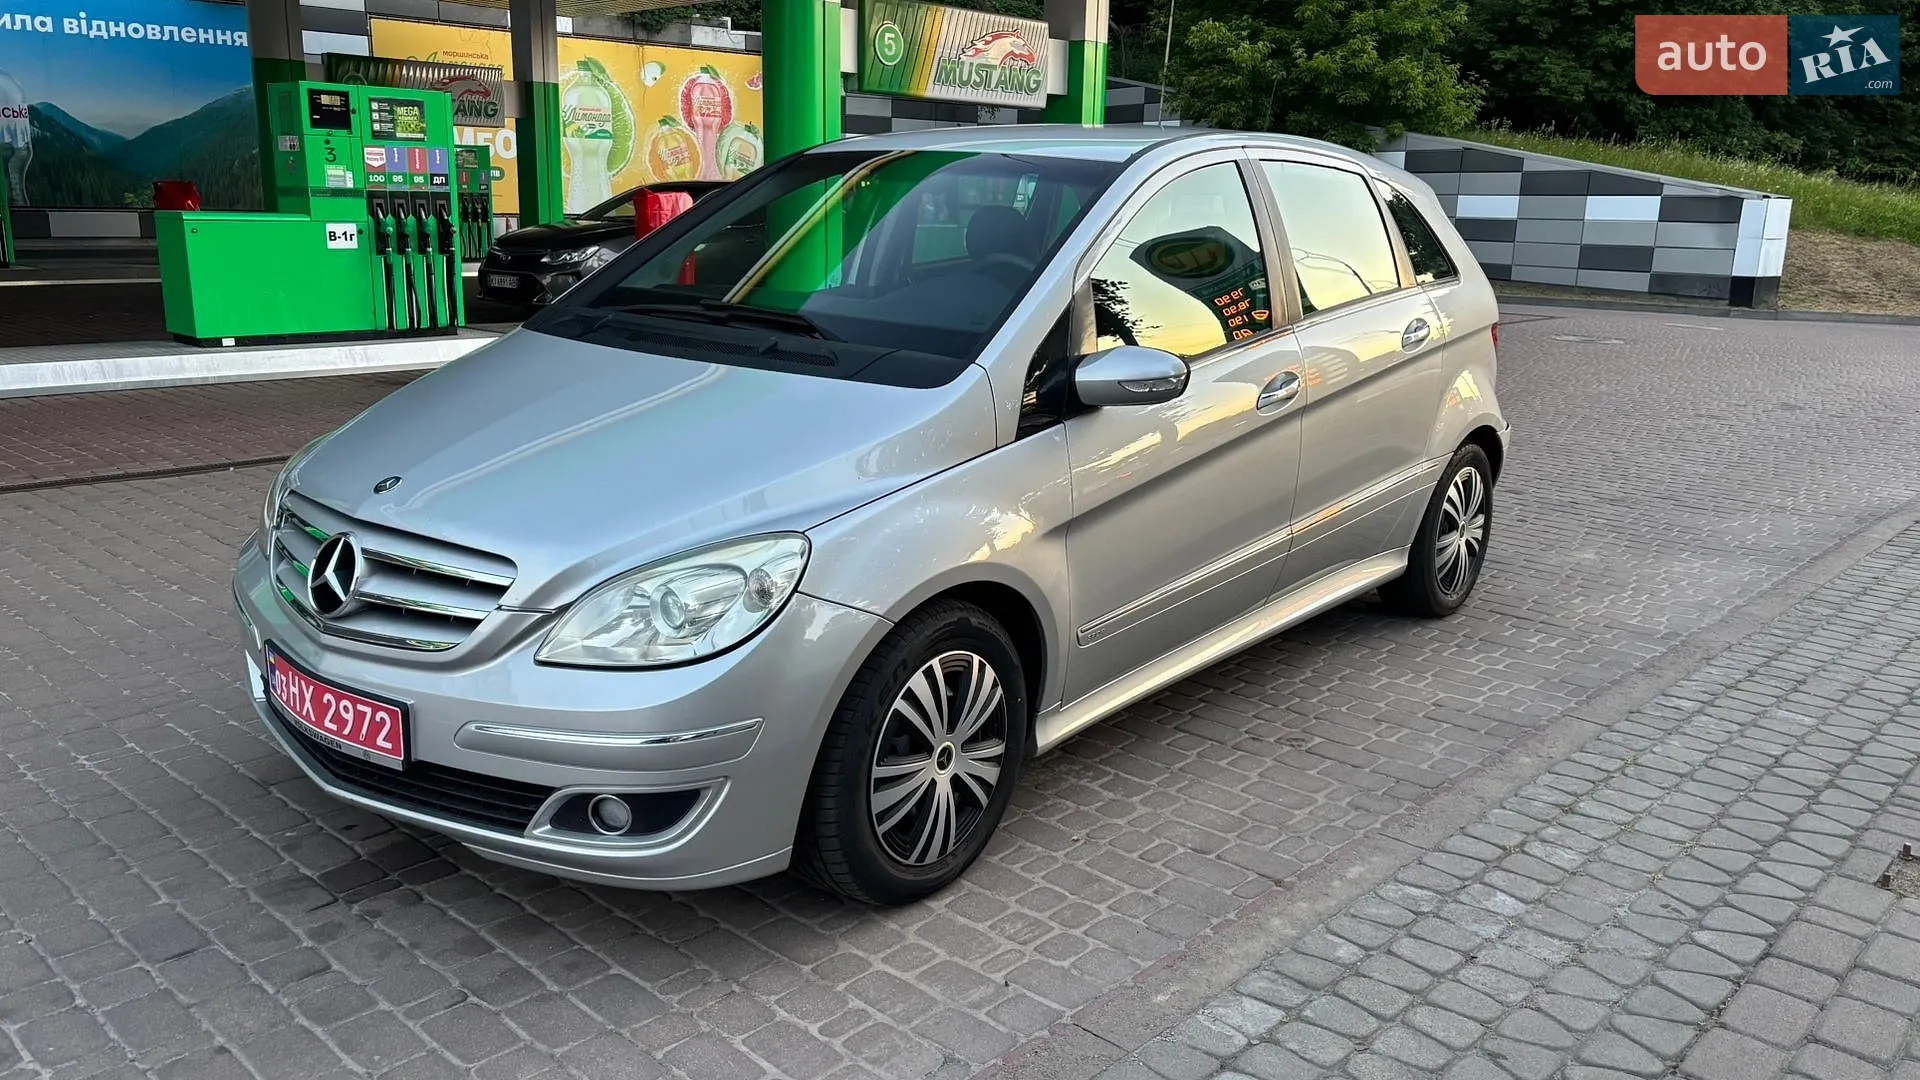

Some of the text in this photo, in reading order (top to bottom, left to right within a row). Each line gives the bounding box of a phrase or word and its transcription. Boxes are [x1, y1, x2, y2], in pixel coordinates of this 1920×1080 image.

[63, 11, 248, 47] відновлення
[883, 32, 896, 56] 5
[933, 58, 1043, 96] MUSTANG
[325, 147, 337, 163] 3
[368, 174, 385, 182] 100
[392, 175, 403, 183] 95
[432, 175, 446, 185] ДП
[322, 692, 393, 749] 2972
